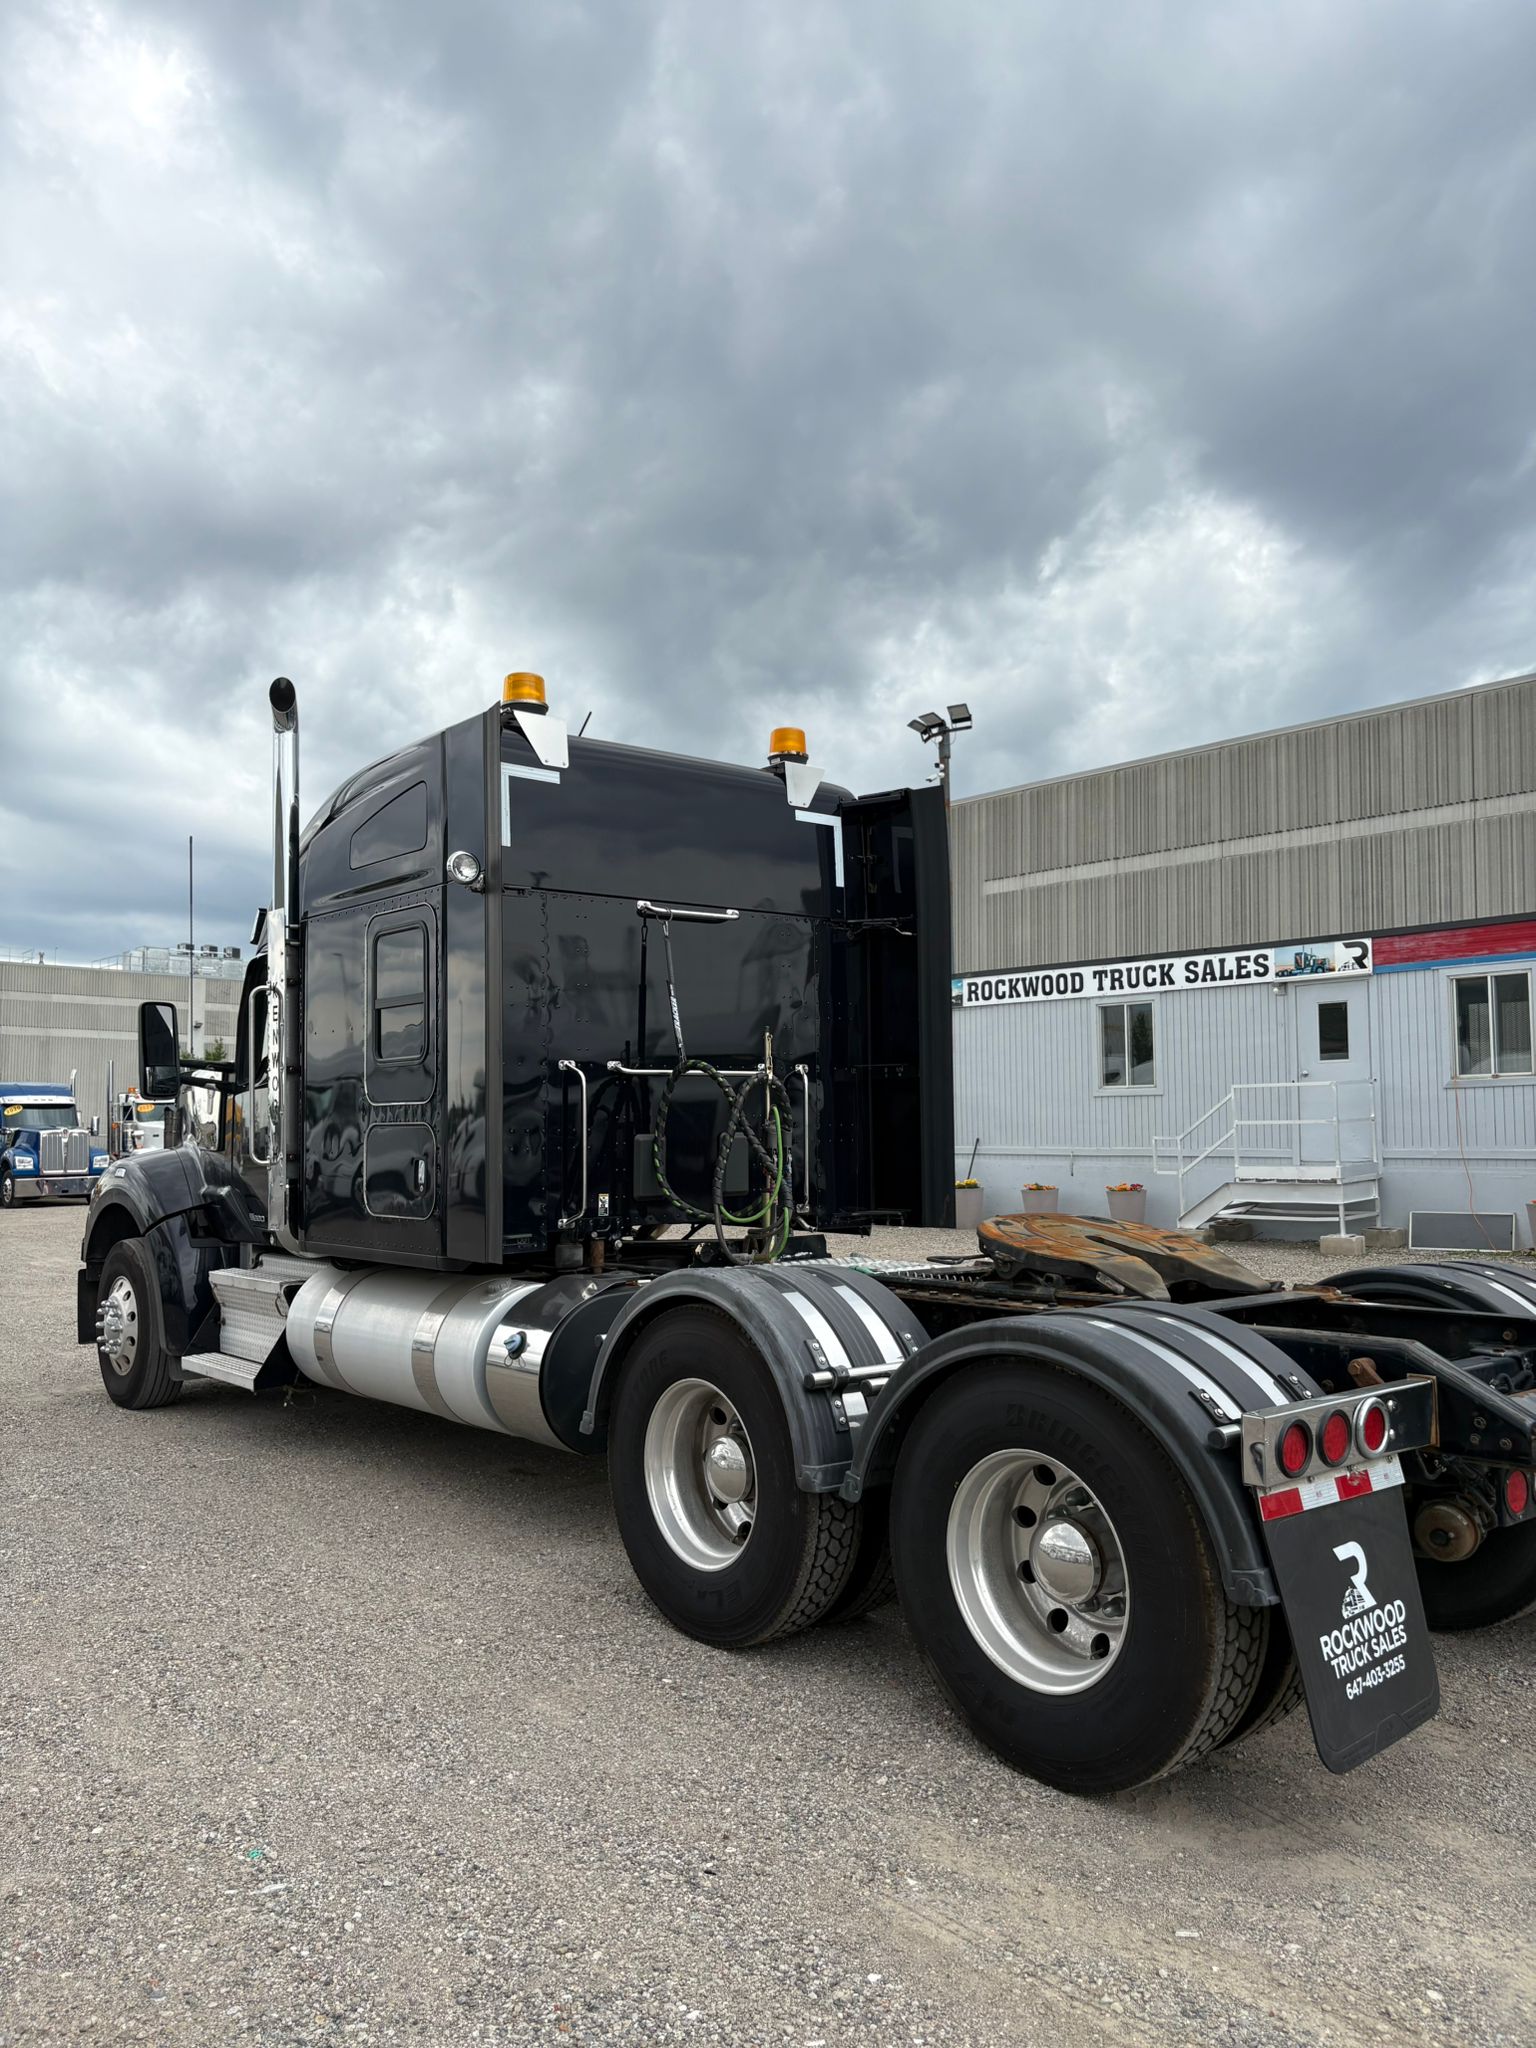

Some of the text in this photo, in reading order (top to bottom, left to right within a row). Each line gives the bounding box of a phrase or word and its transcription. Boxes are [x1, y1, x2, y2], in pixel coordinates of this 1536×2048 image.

[967, 953, 1269, 1003] ROCKWOOD TRUCK SALES
[1319, 1600, 1406, 1661] ROCKWOOD
[1330, 1624, 1407, 1679] TRUCK SALES
[1345, 1654, 1406, 1700] 647-403-3255
